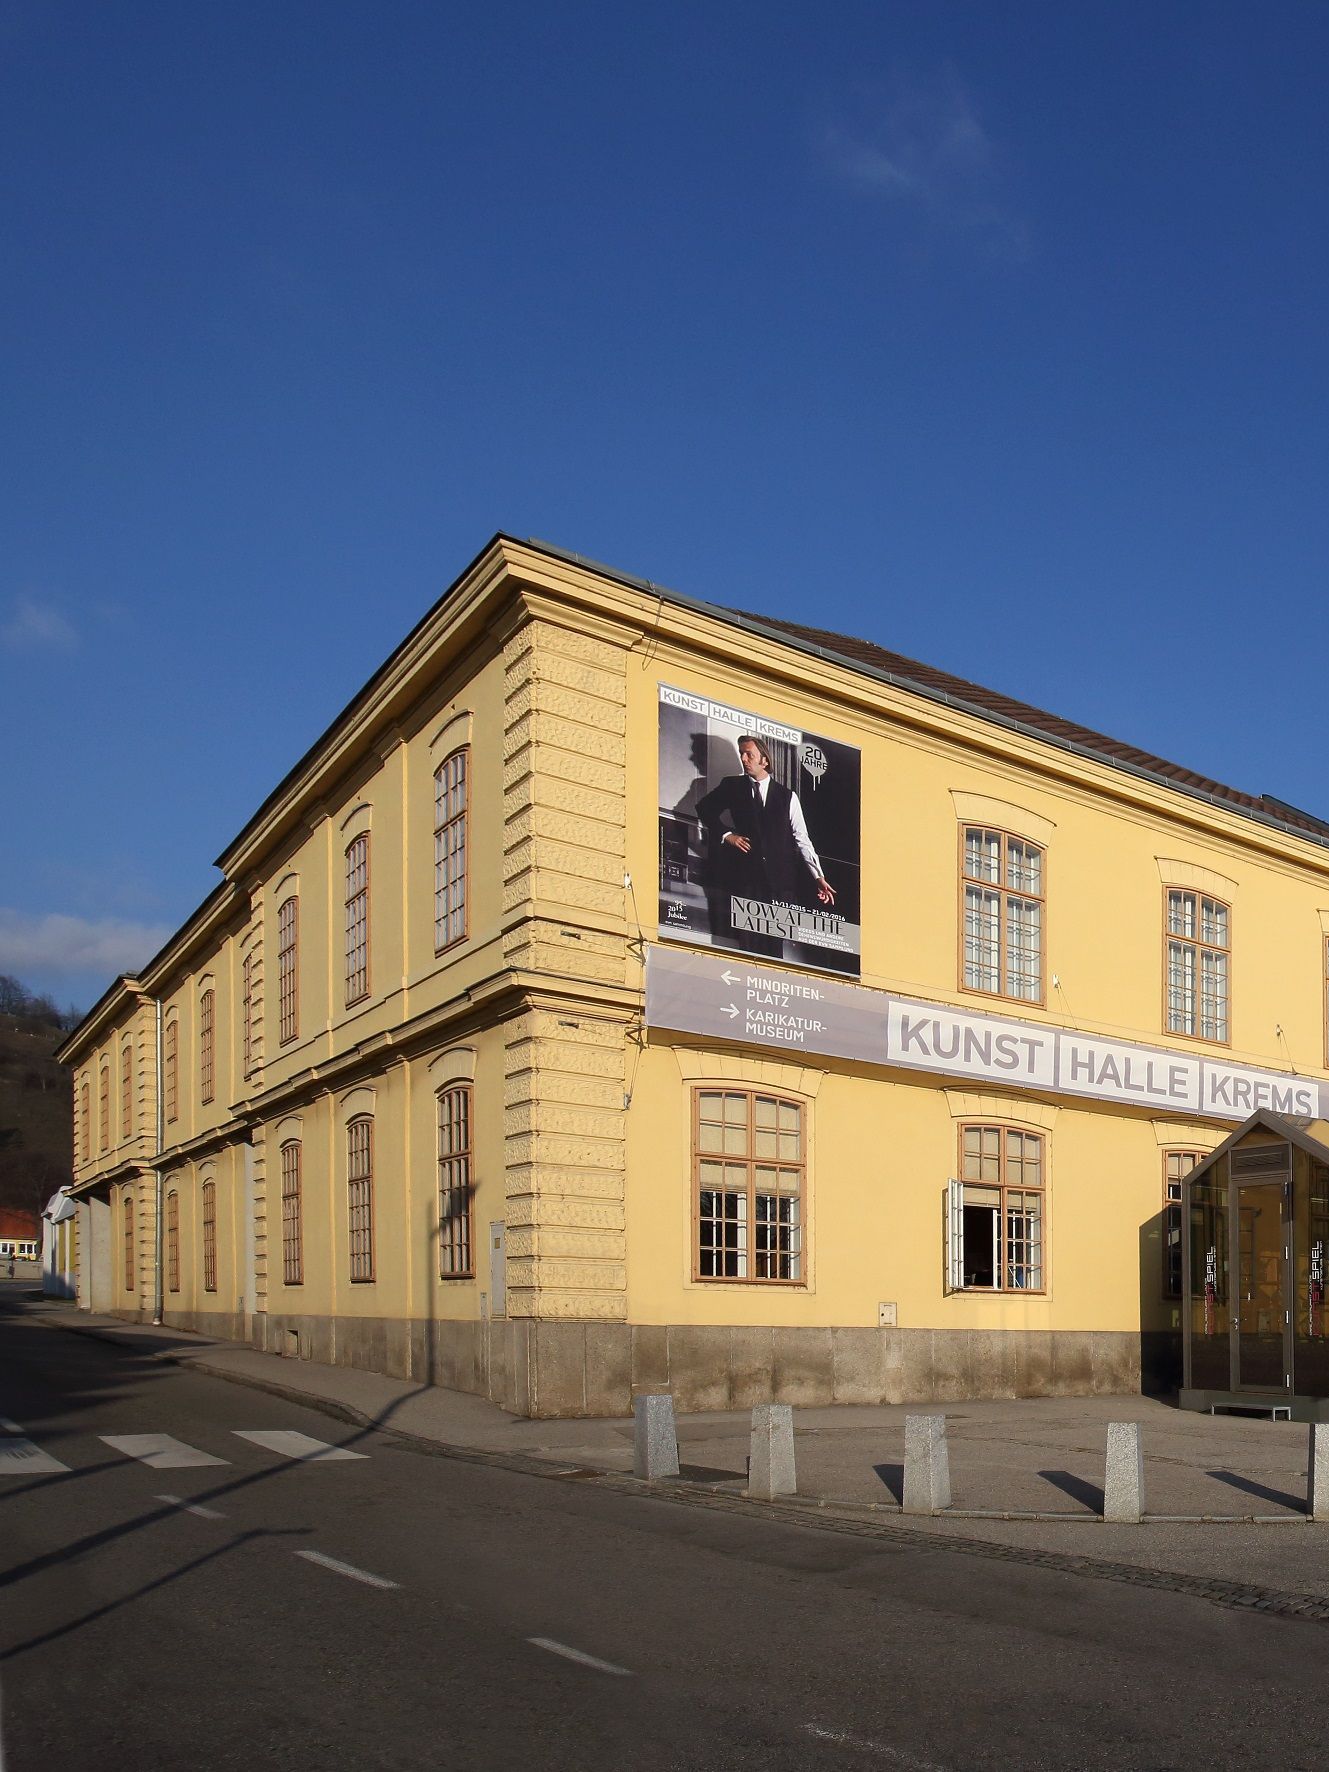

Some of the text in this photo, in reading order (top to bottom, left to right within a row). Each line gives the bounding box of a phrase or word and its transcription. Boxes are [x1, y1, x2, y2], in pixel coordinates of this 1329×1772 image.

[663, 690, 799, 743] KUNST HALLE KREMS
[800, 757, 828, 771] JAHRE
[805, 746, 822, 759] 20
[732, 912, 797, 939] LATEST
[785, 910, 804, 926] AT
[808, 915, 846, 936] THE
[746, 975, 825, 1001] MINORITEN-
[746, 989, 790, 1008] PLATZ
[745, 1021, 804, 1043] MUSEUM
[746, 1008, 828, 1033] KARIKATUR-
[900, 1014, 1313, 1118] KUNST HALLE KREMS
